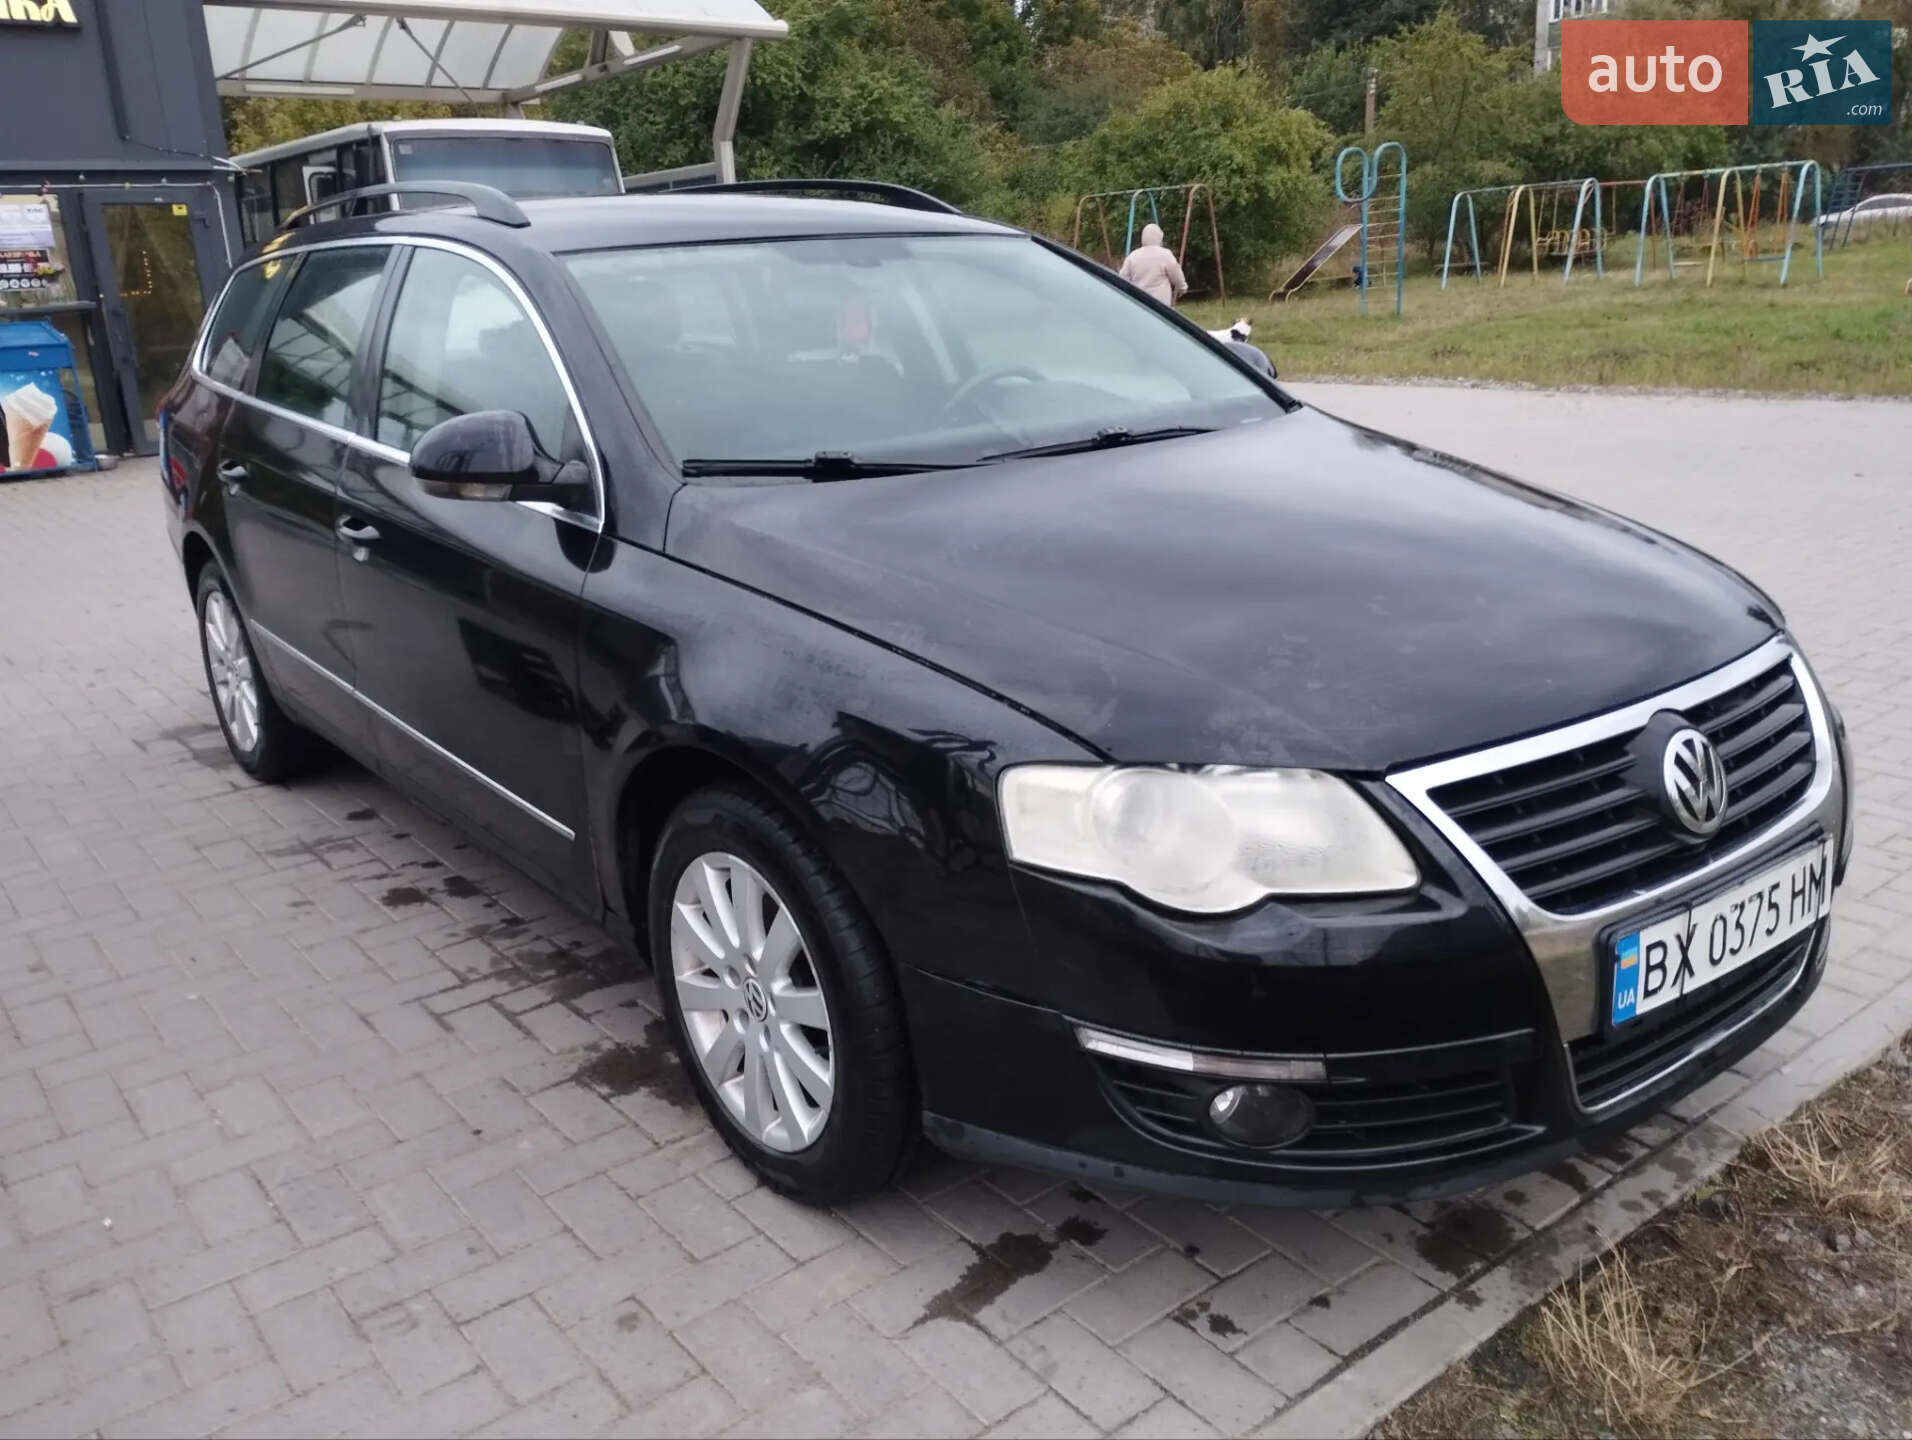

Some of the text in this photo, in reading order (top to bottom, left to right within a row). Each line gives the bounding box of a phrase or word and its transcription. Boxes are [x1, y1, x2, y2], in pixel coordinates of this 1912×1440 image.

[1643, 922, 1697, 1001] BX
[1708, 881, 1781, 968] 0375
[1617, 990, 1635, 1009] UA
